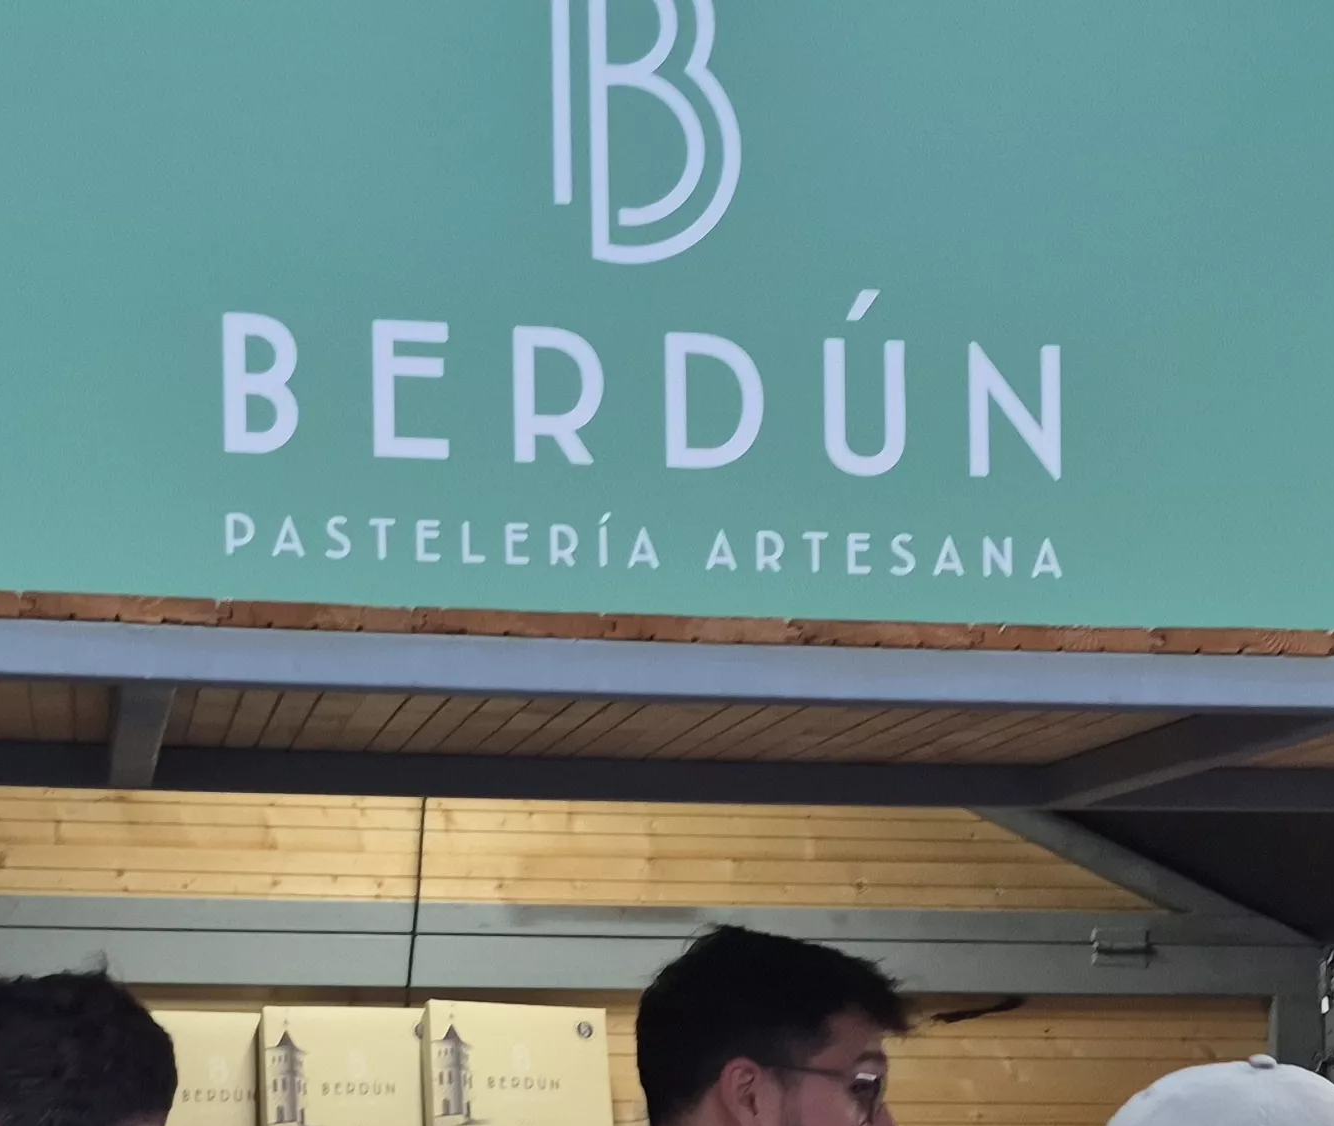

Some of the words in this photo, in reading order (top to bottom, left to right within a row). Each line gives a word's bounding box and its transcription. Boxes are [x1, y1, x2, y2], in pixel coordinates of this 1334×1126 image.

[222, 289, 1062, 481] BERDÚN
[223, 512, 660, 569] PASTELERÍA
[706, 528, 1063, 579] ARTESANA
